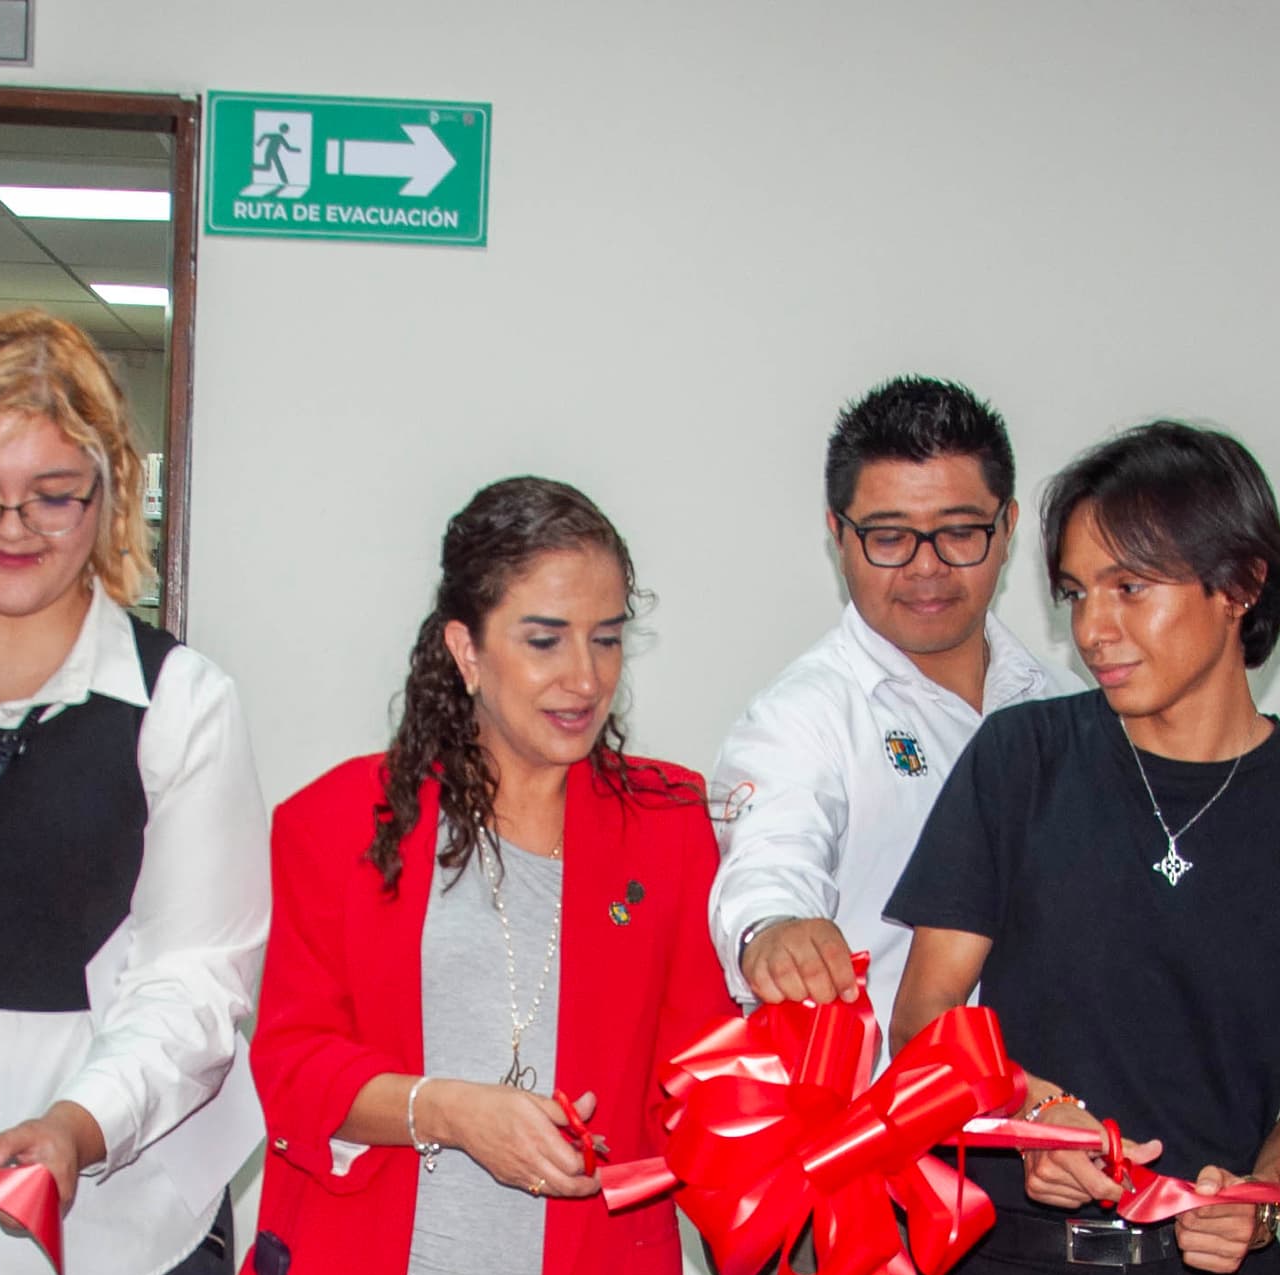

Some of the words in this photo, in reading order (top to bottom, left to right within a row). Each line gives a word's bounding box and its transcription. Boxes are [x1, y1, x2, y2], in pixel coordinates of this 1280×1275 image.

[232, 200, 288, 221] RUTA
[292, 203, 321, 222] DE
[325, 204, 459, 229] EVACUACIÓN
